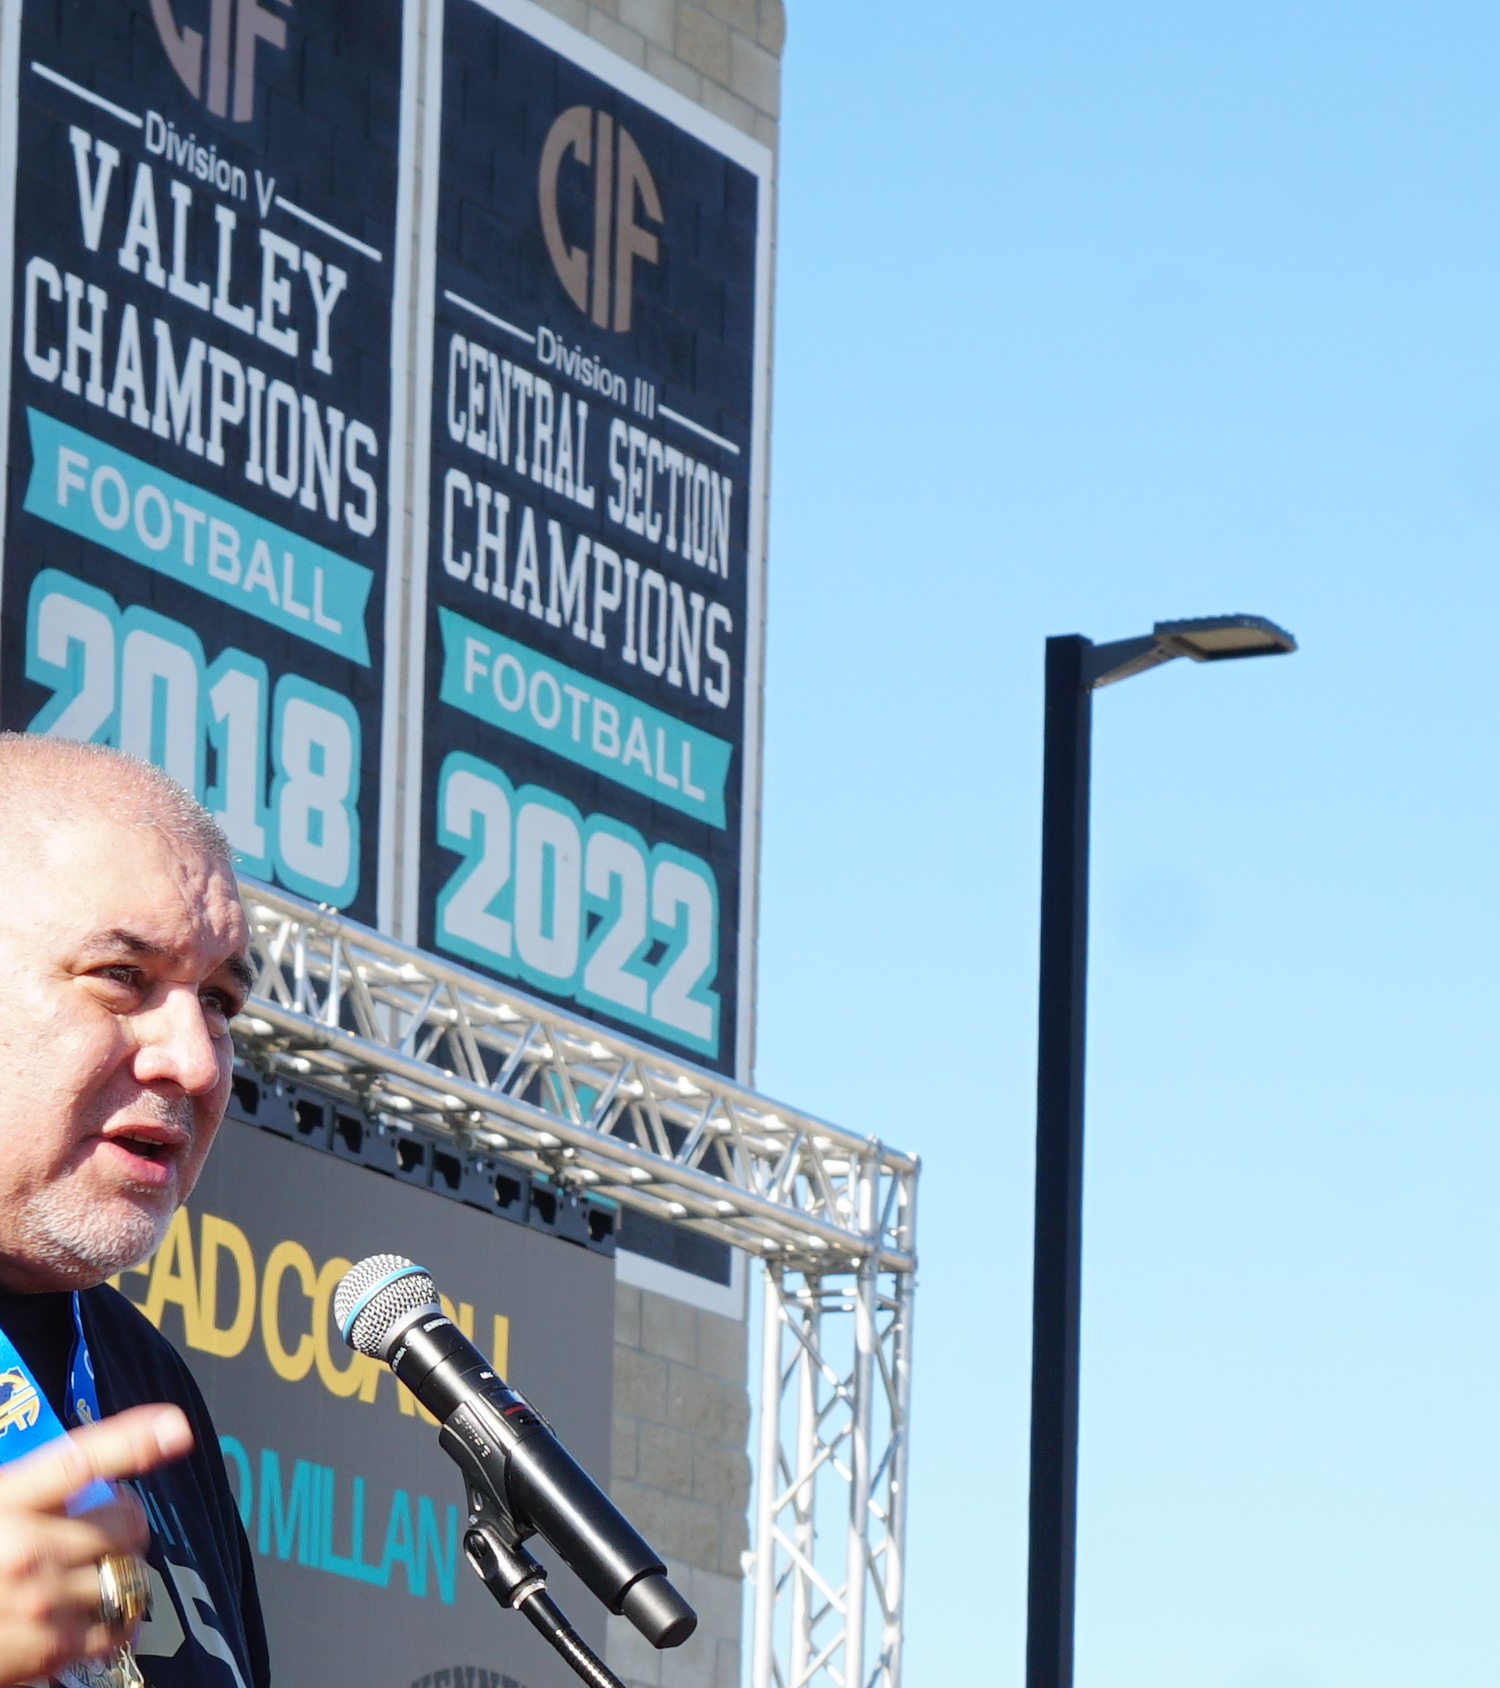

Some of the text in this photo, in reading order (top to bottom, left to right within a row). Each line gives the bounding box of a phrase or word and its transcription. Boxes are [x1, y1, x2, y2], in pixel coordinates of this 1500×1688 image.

[68, 125, 348, 375] VALLEY
[145, 109, 275, 219] Division V
[538, 104, 665, 334] CIF
[23, 255, 378, 538] CHAMPIONS
[447, 333, 733, 580] CENTRAL SECTION
[536, 325, 656, 421] Division III
[55, 445, 342, 636] FOOTBALL
[441, 467, 733, 710] CHAMPIONS
[30, 582, 357, 896] 2018
[463, 636, 706, 802] FOOTBALL
[438, 758, 717, 1050] 2022
[257, 1447, 458, 1606] MILLAN
